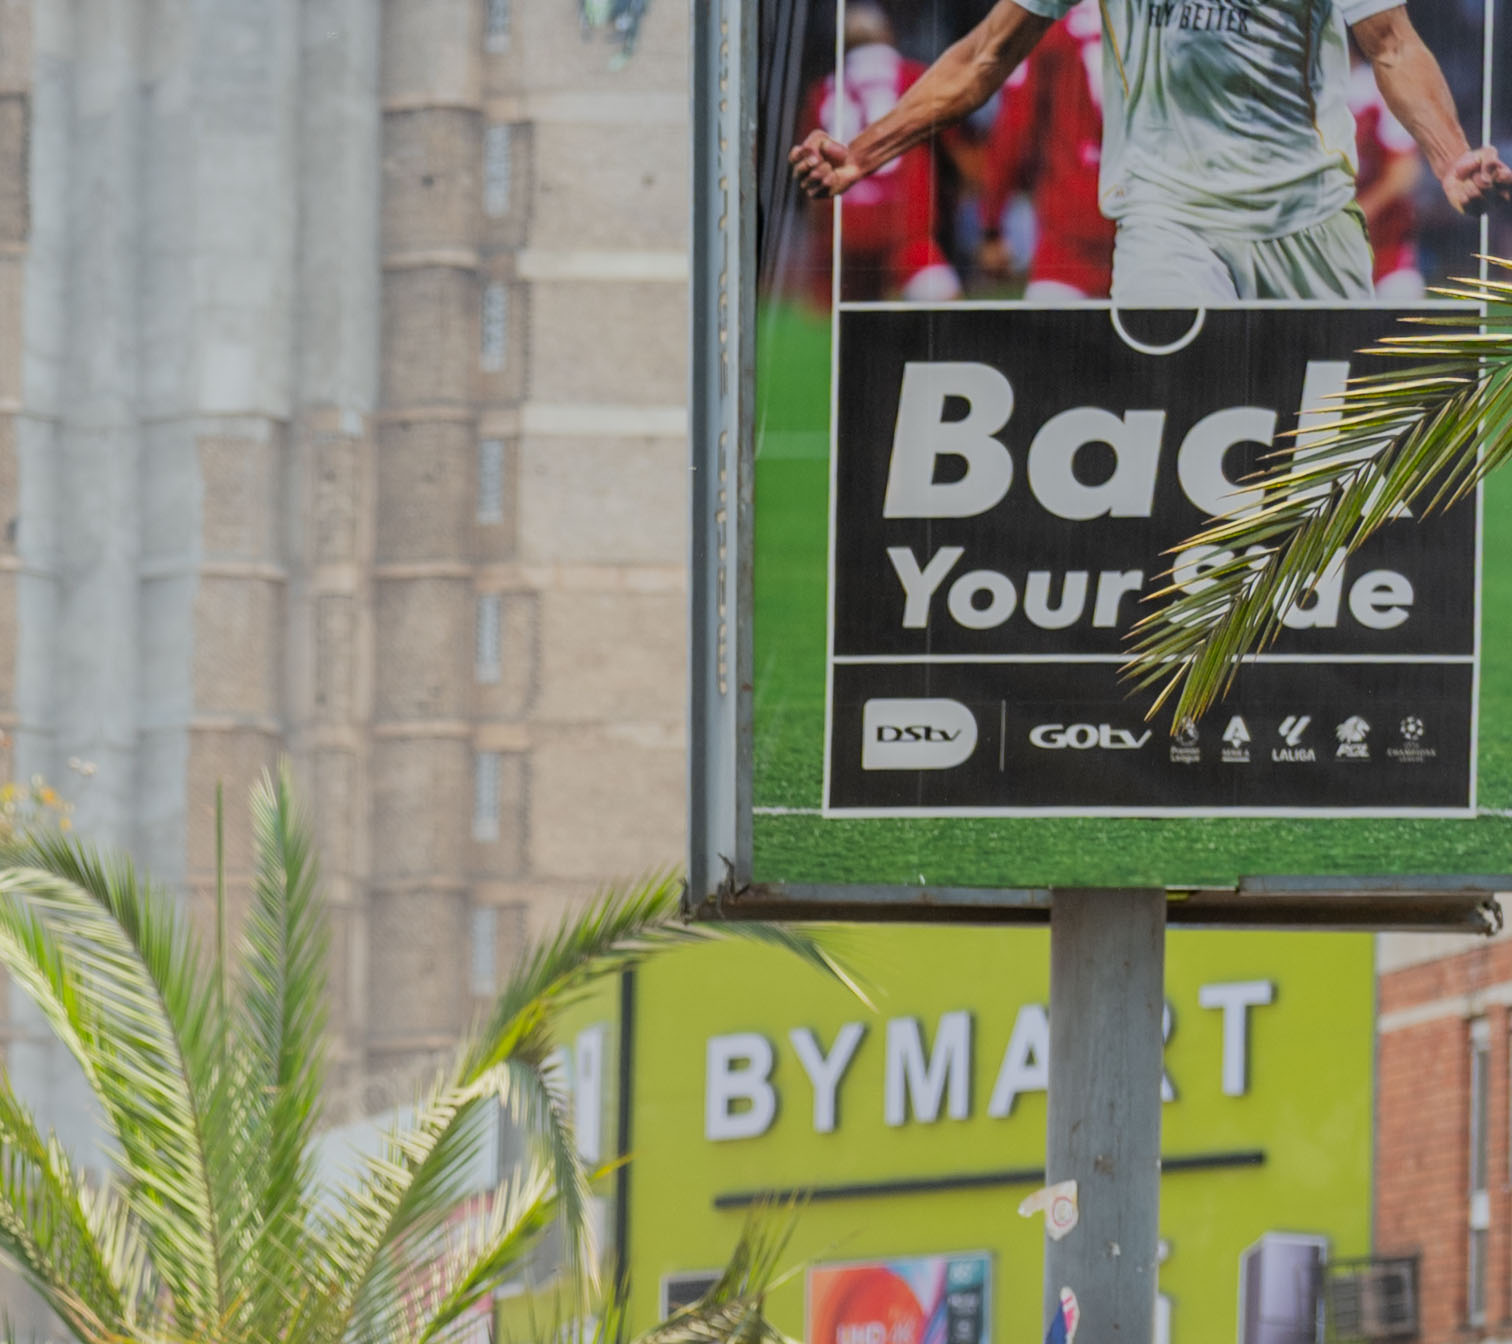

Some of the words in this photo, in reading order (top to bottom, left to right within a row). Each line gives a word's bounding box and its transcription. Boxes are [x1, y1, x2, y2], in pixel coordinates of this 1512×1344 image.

[1179, 4, 1248, 33] BETTER
[886, 546, 1144, 629] Your
[877, 725, 962, 742] DStv
[1029, 723, 1152, 749] GOtv
[1272, 748, 1316, 762] LALIGA
[706, 979, 1272, 1142] BYMAT
